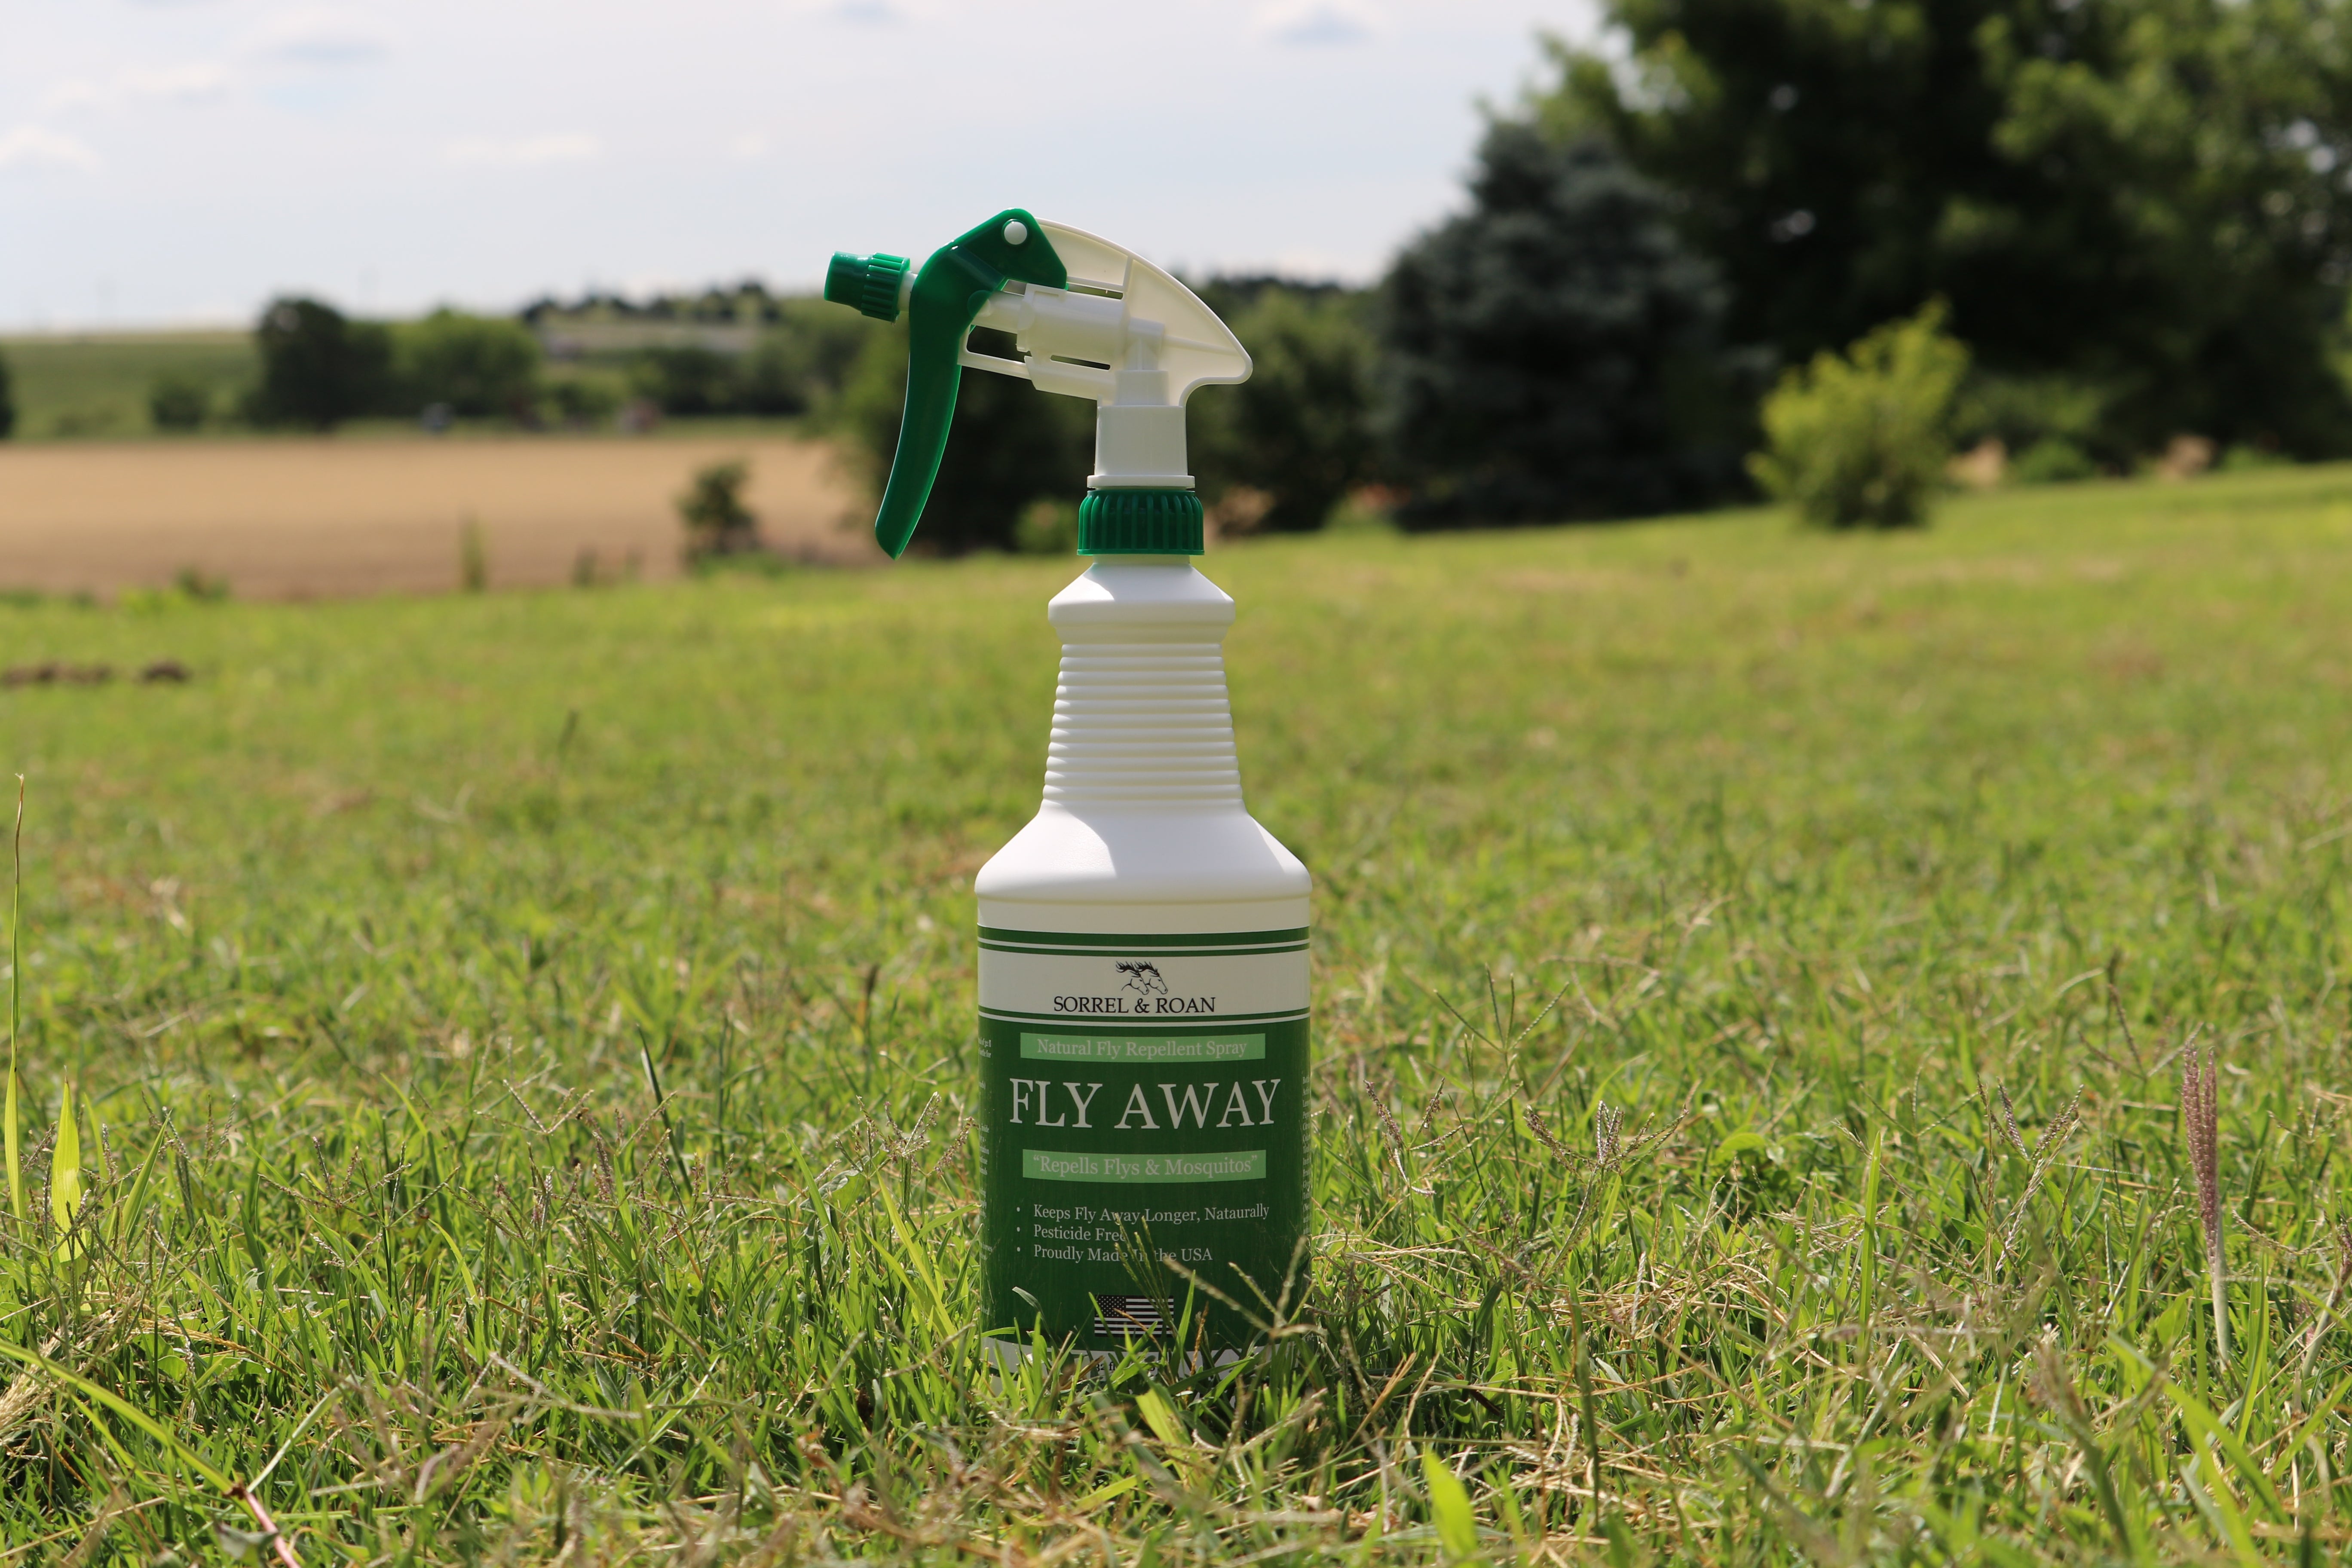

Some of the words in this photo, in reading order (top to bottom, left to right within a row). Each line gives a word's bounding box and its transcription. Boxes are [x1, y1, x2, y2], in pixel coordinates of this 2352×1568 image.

[1054, 996, 1129, 1013] SORREL
[1135, 998, 1149, 1013] &
[1155, 997, 1216, 1013] ROAN
[1038, 1039, 1091, 1055] Natural
[1096, 1041, 1121, 1060] Fly
[1126, 1041, 1202, 1060] Repellent
[1207, 1041, 1247, 1059] Spray
[1010, 1078, 1102, 1128] FLY
[1114, 1078, 1281, 1129] AWAY
[1104, 1158, 1139, 1179] Flys
[1145, 1159, 1160, 1175] &
[1034, 1204, 1070, 1222] Keeps
[1075, 1207, 1096, 1223] Fly
[1099, 1208, 1140, 1225] Away
[1145, 1209, 1200, 1225] Longer,
[1204, 1203, 1269, 1219] Nataurally
[1034, 1224, 1091, 1240] Pesticide
[1034, 1244, 1084, 1263] Proudly
[1087, 1248, 1128, 1262] Made
[1153, 1248, 1176, 1262] the
[1181, 1248, 1213, 1261] USA
